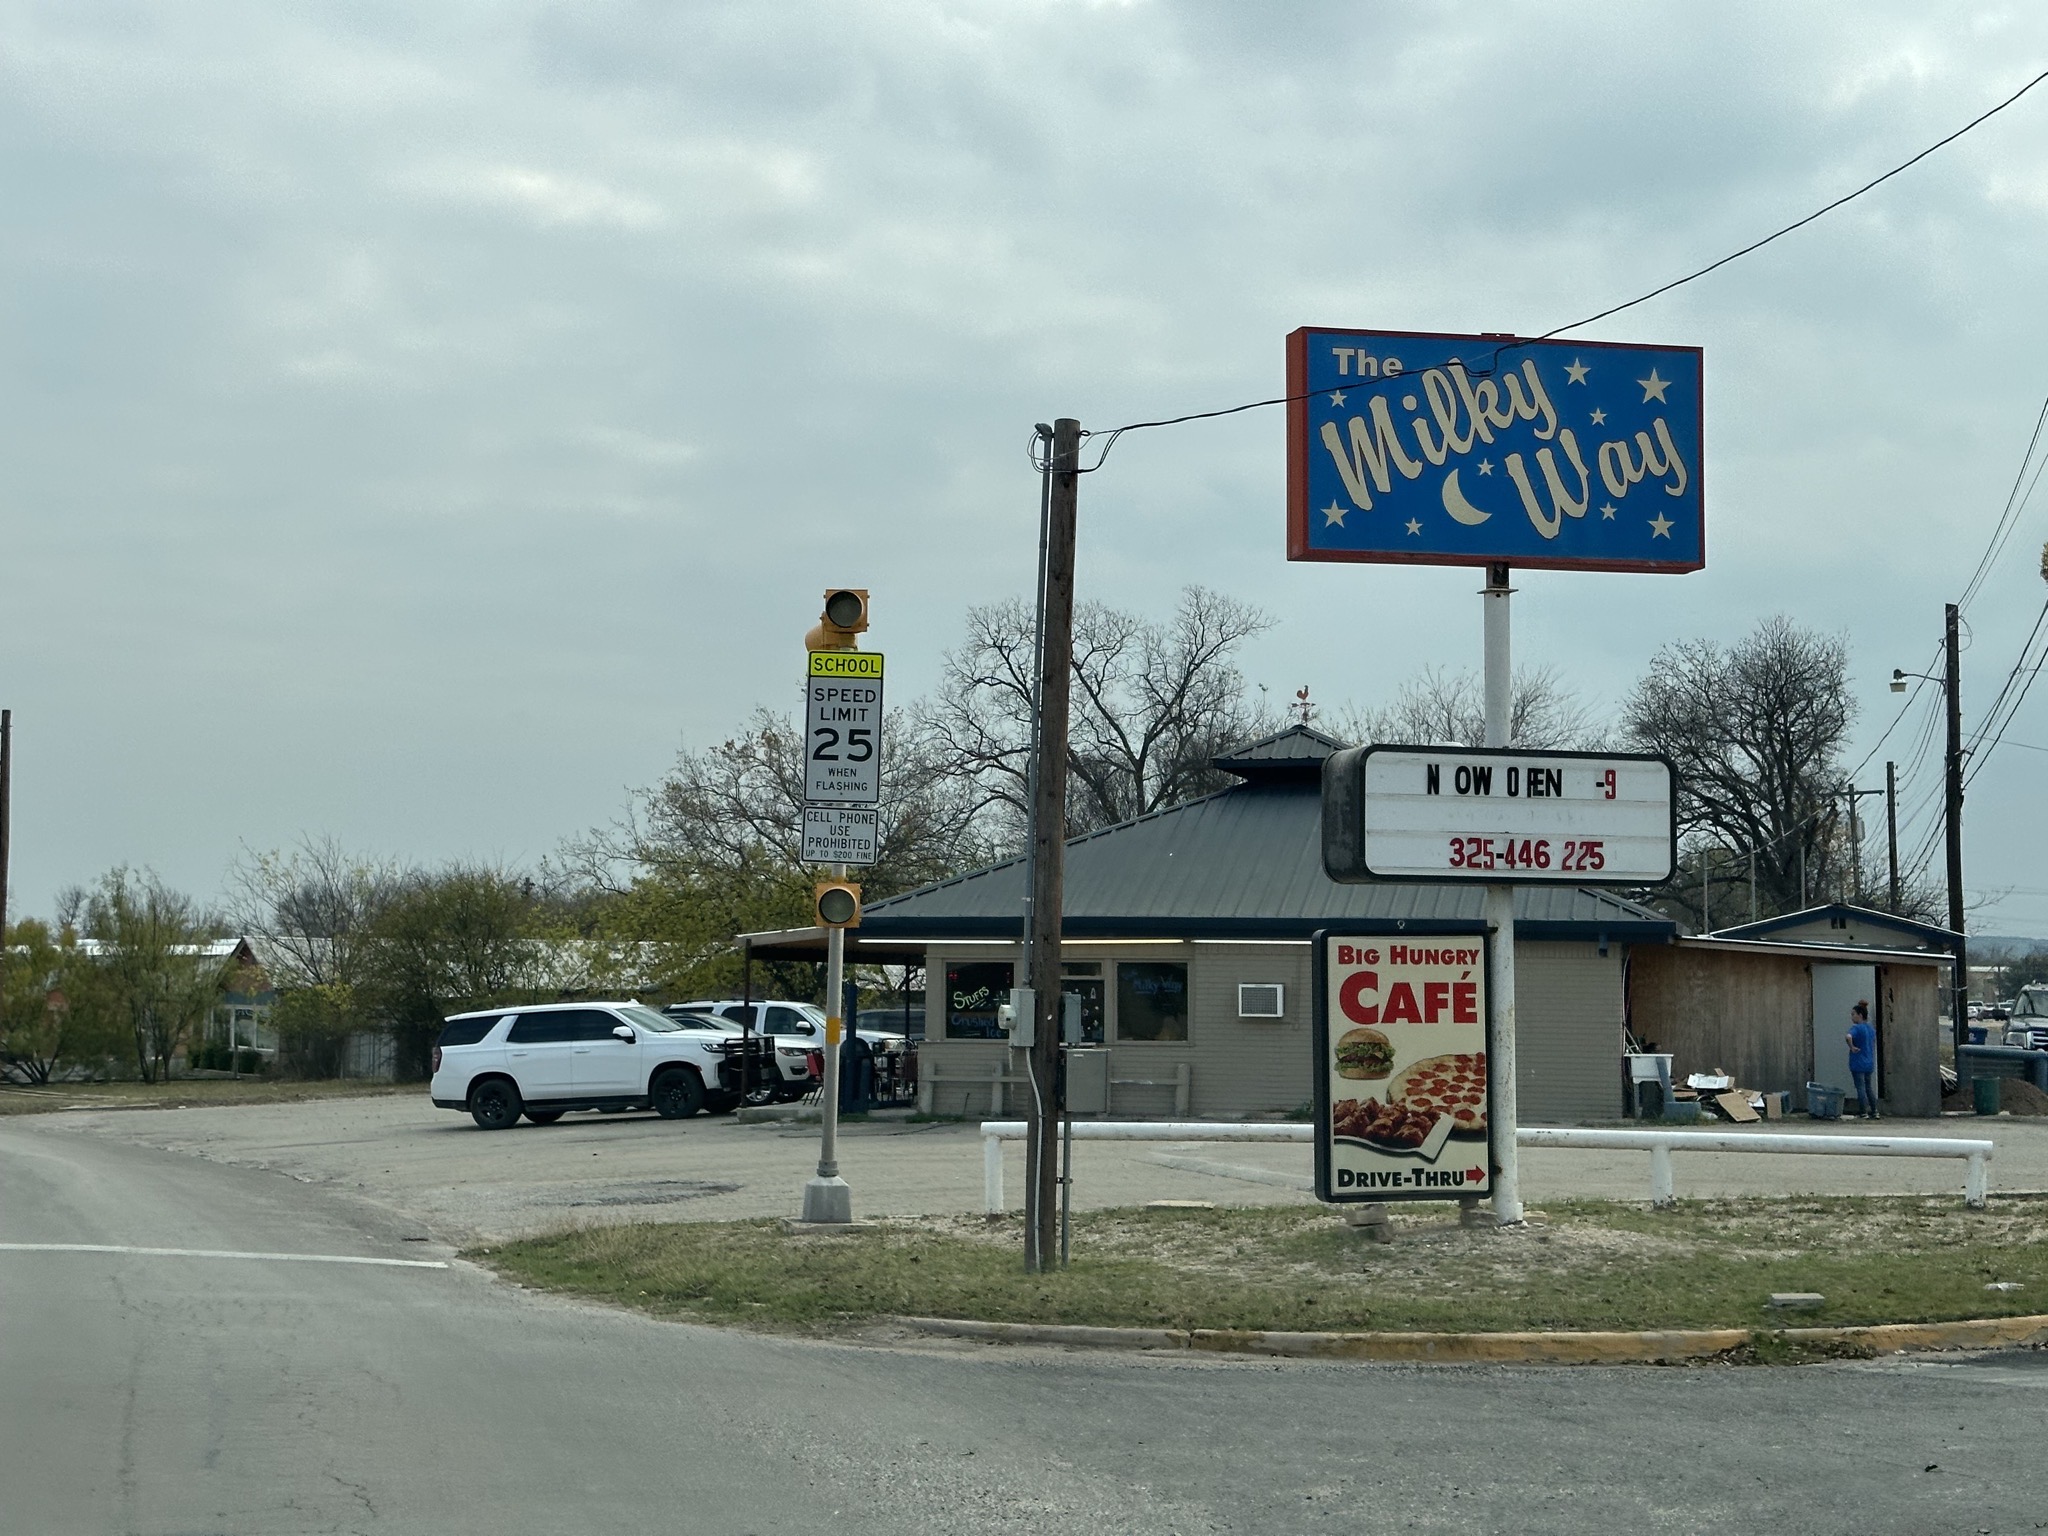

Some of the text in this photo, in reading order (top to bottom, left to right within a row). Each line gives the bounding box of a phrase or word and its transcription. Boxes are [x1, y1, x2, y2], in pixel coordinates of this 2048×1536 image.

[1332, 347, 1403, 379] The
[1320, 357, 1558, 511] Milky
[1505, 417, 1688, 539] Way
[814, 657, 880, 674] SCHOOL
[814, 687, 877, 703] SPEED
[821, 707, 869, 722] LIMIT
[812, 727, 873, 762] 25
[828, 767, 858, 778] WHEN
[815, 781, 868, 792] FLASHING
[807, 811, 875, 825] CELL PHONE
[830, 825, 851, 837] USE
[808, 837, 871, 850] PROHIBITED
[805, 849, 872, 860] UP TO $200 FINE
[1449, 837, 1551, 870] 325-446
[1338, 945, 1480, 965] BIG HUNGRY
[1339, 971, 1478, 1025] CAFÉ
[1337, 1168, 1465, 1188] DRIVE-THRU
